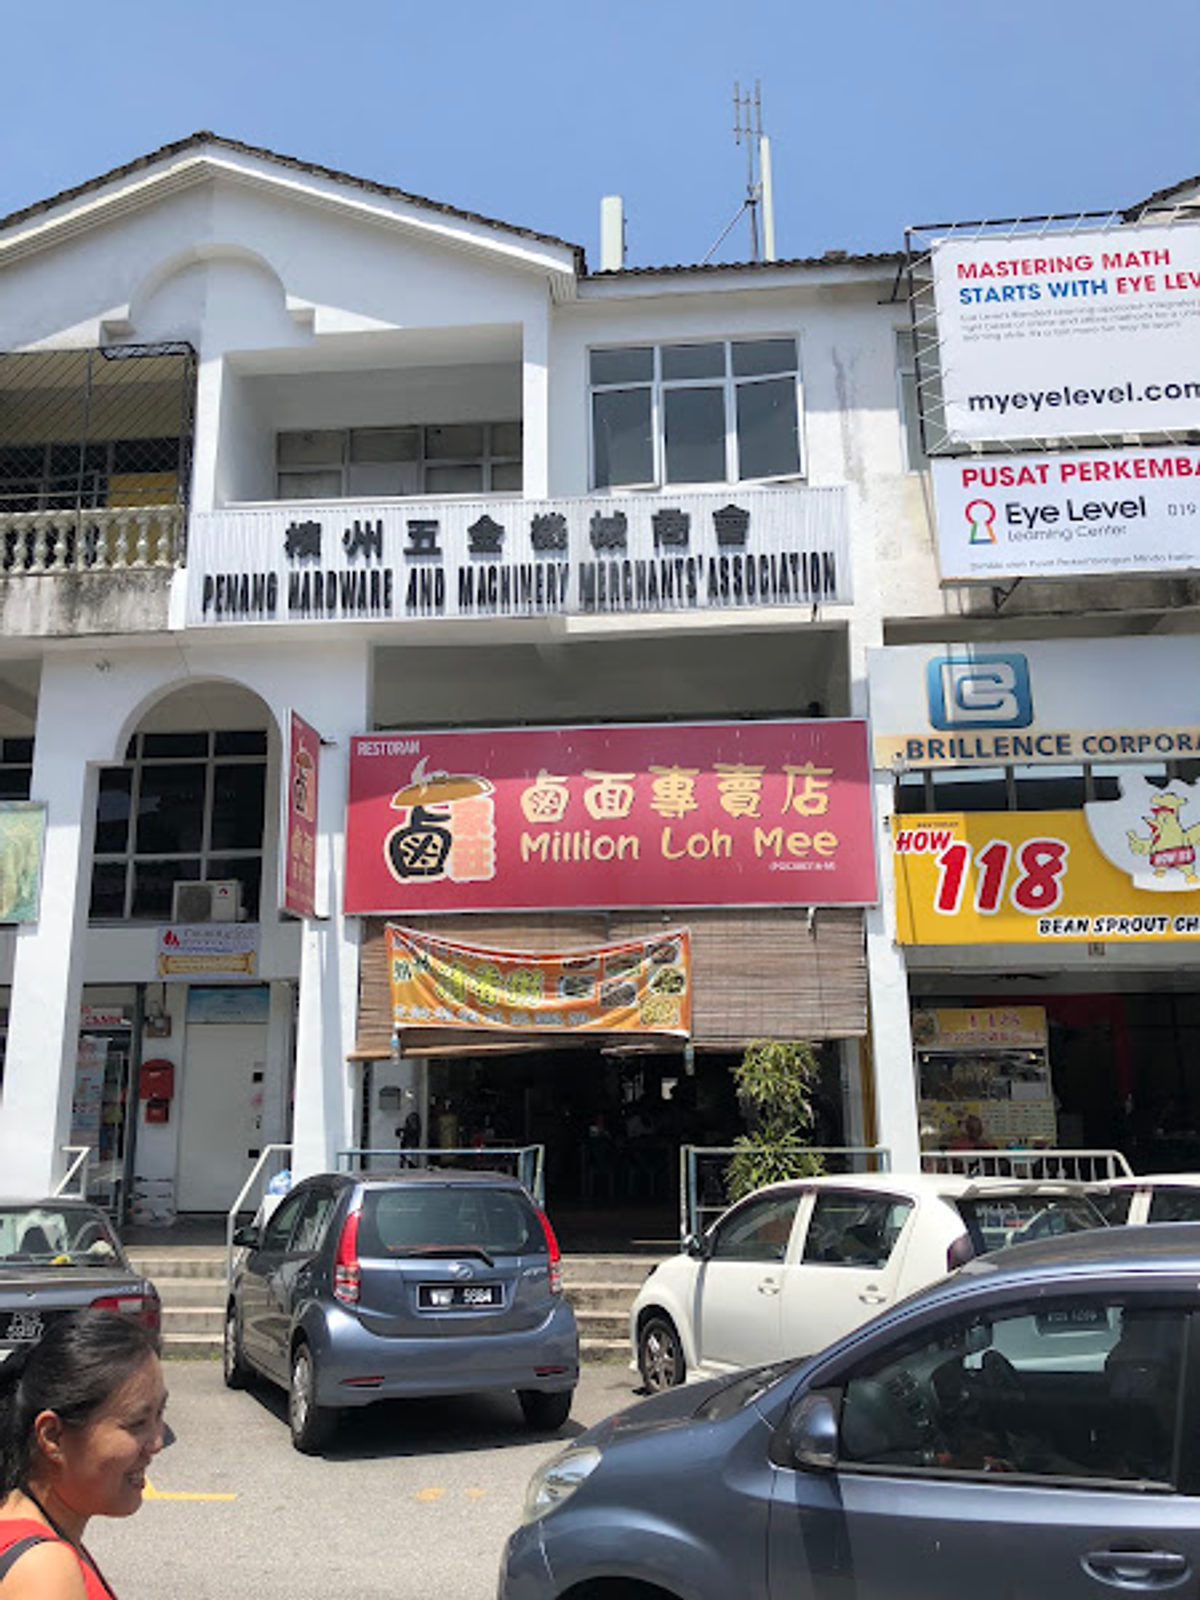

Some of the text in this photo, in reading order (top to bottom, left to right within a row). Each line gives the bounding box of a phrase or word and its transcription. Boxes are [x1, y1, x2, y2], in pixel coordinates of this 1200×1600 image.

[957, 249, 1170, 279] MASTERING MATH
[959, 284, 1041, 305] STARTS
[1048, 279, 1108, 298] WITH
[1117, 275, 1156, 294] EYE
[962, 465, 1049, 488] PUSAT
[1005, 502, 1060, 528] Eye
[1066, 496, 1147, 522] Level
[1008, 525, 1127, 542] Learning Center
[202, 571, 278, 613] PENANG
[288, 568, 393, 611] HARDWARE
[405, 567, 446, 607] AND
[458, 563, 569, 605] MACHINERY
[707, 551, 836, 599] ASSOCIATION
[357, 740, 420, 756] RESTORAN
[906, 735, 1072, 760] BRILLENCE
[520, 826, 839, 862] Million Loh Mee
[896, 831, 951, 851] HOW
[937, 839, 1068, 912] 118
[1040, 919, 1089, 934] BEAN
[1093, 917, 1168, 934] SPROUT
